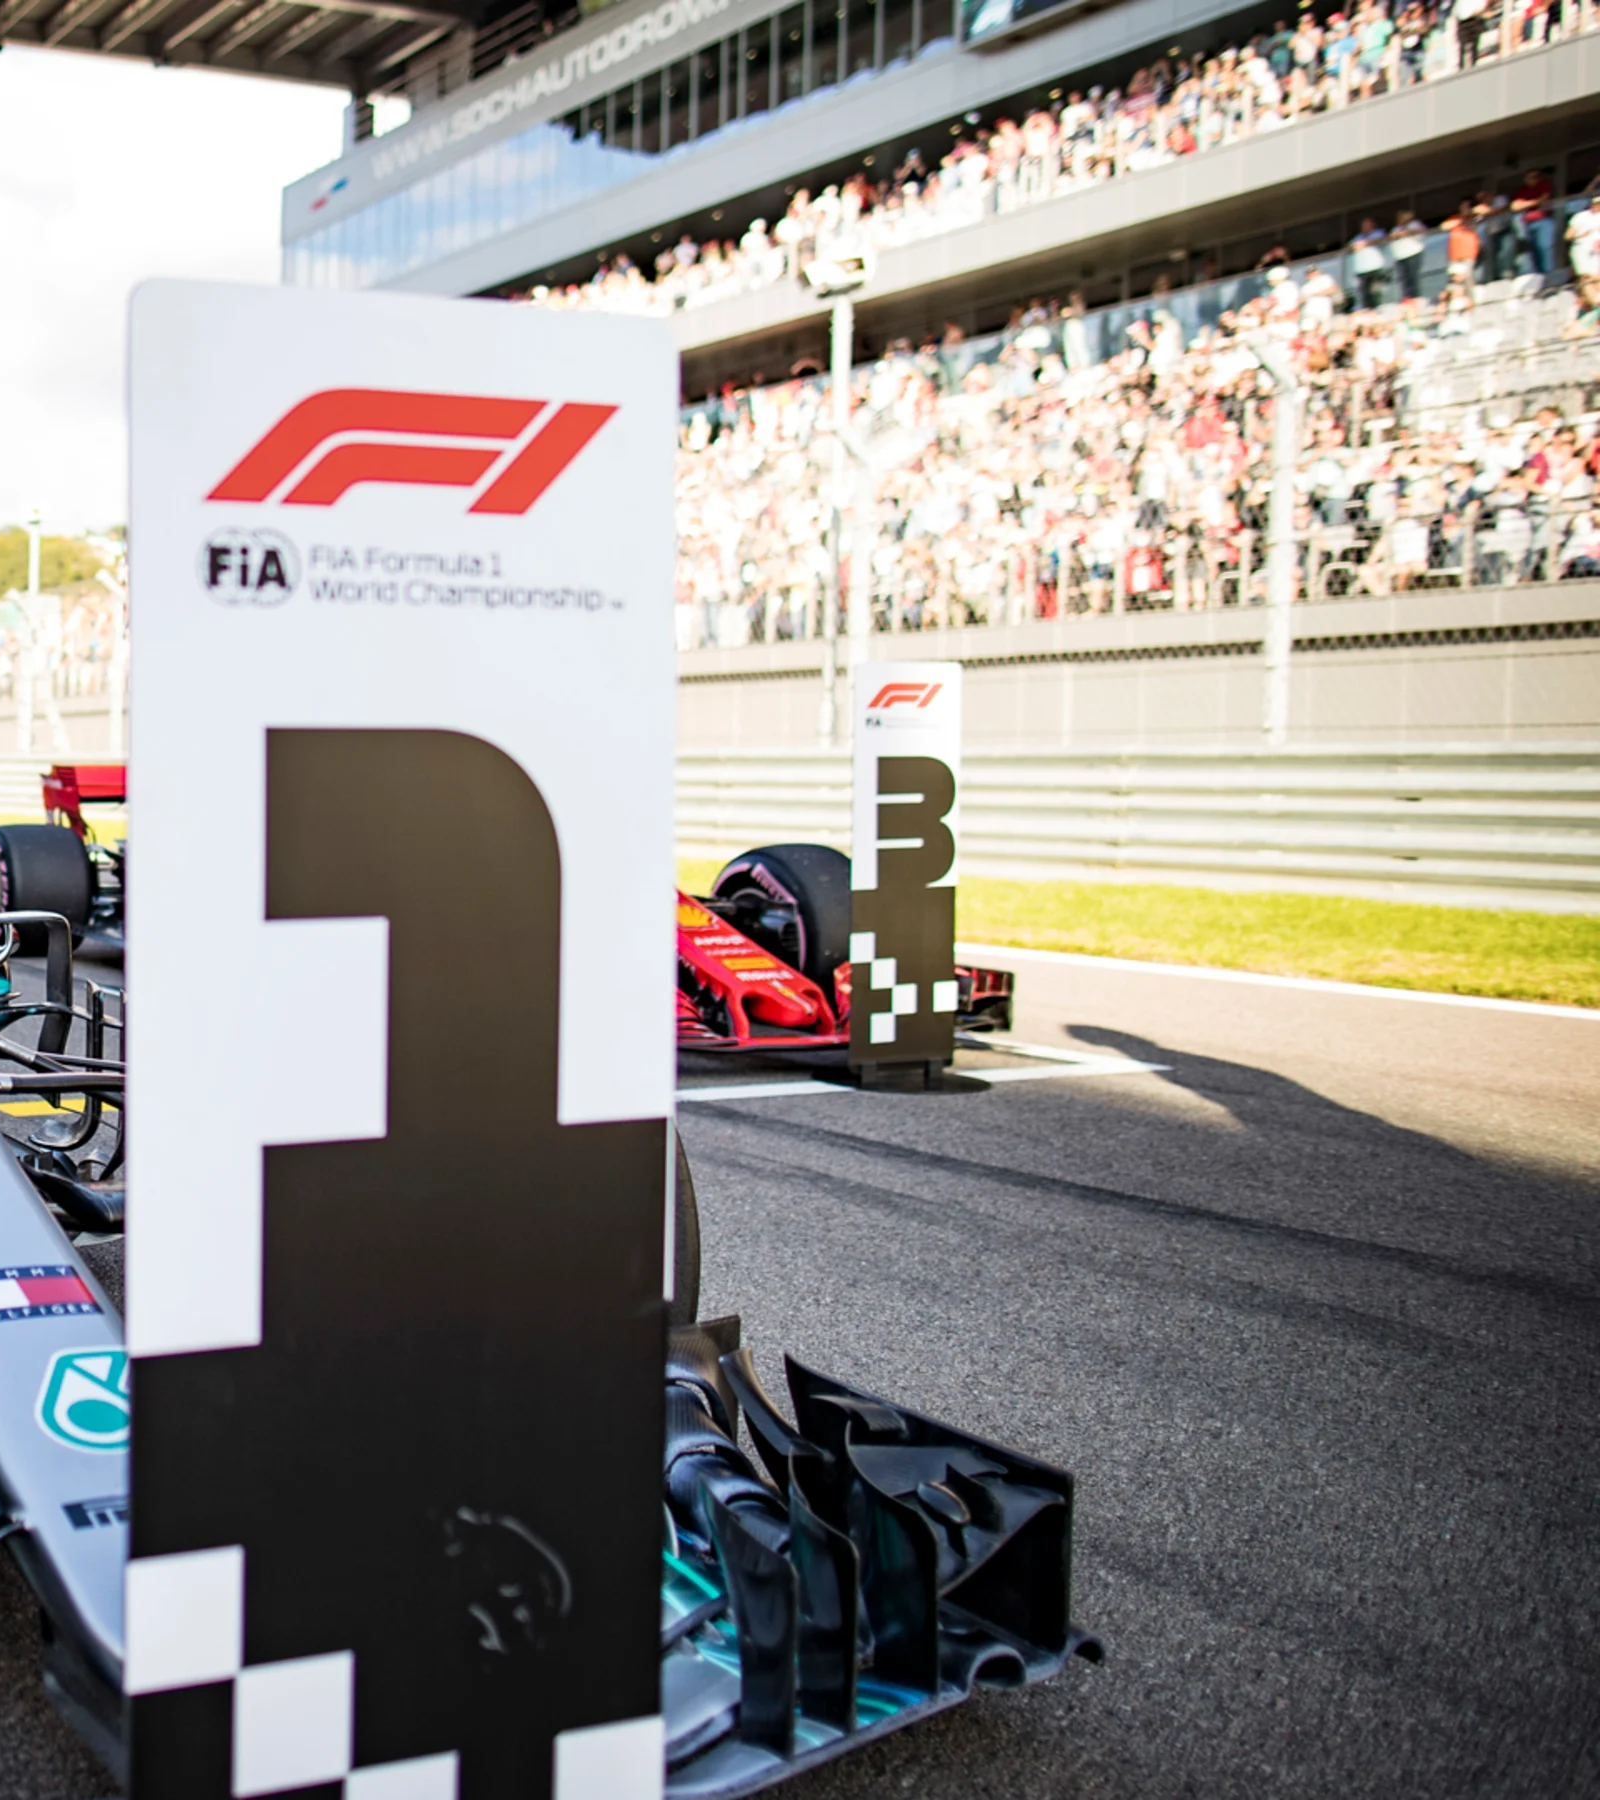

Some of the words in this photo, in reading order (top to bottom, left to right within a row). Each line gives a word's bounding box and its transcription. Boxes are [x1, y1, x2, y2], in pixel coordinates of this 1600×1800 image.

[368, 0, 730, 181] WWW.SOCHIAUTODROM
[204, 388, 619, 515] F1
[311, 545, 357, 571] FIA
[364, 547, 483, 577] Formula
[490, 552, 502, 578] 1
[311, 578, 395, 604] World
[404, 580, 602, 613] Championship
